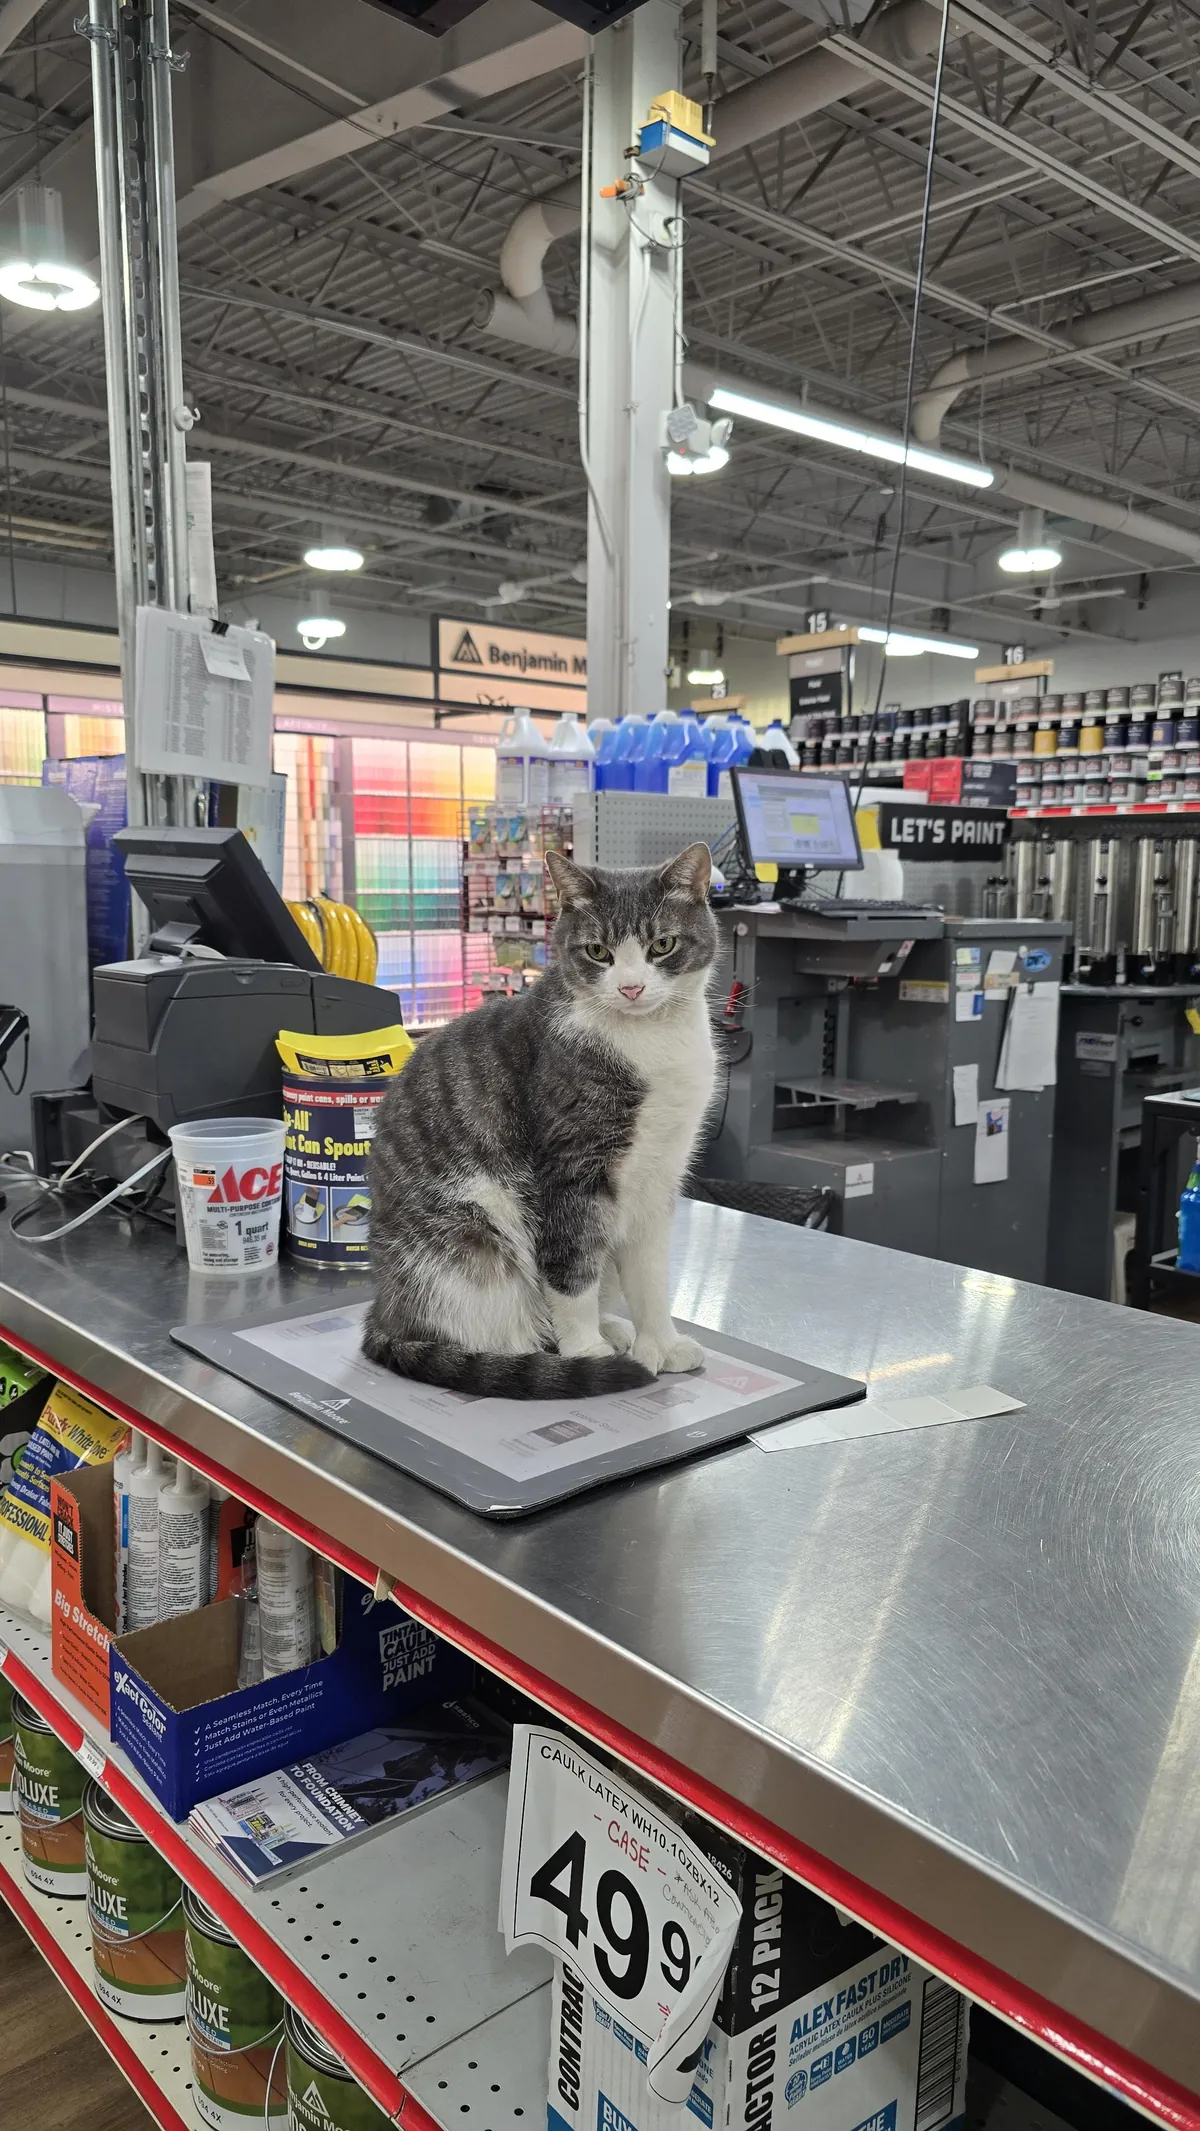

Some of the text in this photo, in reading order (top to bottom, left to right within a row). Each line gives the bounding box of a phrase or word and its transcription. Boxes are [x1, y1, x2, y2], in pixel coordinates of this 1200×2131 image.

[808, 612, 827, 634] 15
[489, 643, 567, 673] Benjamin
[1005, 646, 1024, 665] 16
[891, 818, 1005, 844] LET'S PAINT
[336, 1094, 357, 1106] spills
[359, 1096, 368, 1104] or
[297, 1134, 371, 1160] Can Spout
[207, 1163, 282, 1203] ACE
[207, 1203, 260, 1213] MULTI-PURPOSE
[235, 1221, 242, 1236] 1
[246, 1222, 269, 1236] quart
[320, 1409, 347, 1424] Moore
[55, 1589, 71, 1618] Big
[72, 1611, 109, 1653] Stretch
[383, 1643, 436, 1674] JUST ADD
[382, 1654, 436, 1692] PAINT
[113, 1670, 167, 1736] eXact Color
[204, 1689, 323, 1741] Match Stains or Even Metallics
[205, 1723, 212, 1731] A
[213, 1708, 252, 1728] Seamless
[281, 1688, 303, 1702] Every
[304, 1679, 323, 1692] Time
[453, 1705, 480, 1728] sashco
[204, 1702, 315, 1752] Just Add Water-Based Paint
[23, 1759, 50, 1778] Moore
[540, 1745, 586, 1783] CAULK
[588, 1776, 629, 1818] LATEX
[278, 1790, 286, 1800] for
[283, 1797, 297, 1814] every
[290, 1765, 355, 1832] TO FOUNDATION
[302, 1762, 328, 1790] FROM
[325, 1785, 365, 1824] CHIMNEY
[281, 1778, 318, 1820] high-performance
[315, 1815, 333, 1837] sealant
[607, 1820, 651, 1872] CASE
[92, 1866, 118, 1886] Moore
[707, 1852, 733, 1880] 18426
[44, 1874, 55, 1886] 4X
[750, 1868, 783, 2013] 12 PACK
[192, 1967, 220, 1994] Moore
[111, 1995, 122, 2005] 4X
[788, 1953, 910, 2046] ALEX FAST DRY
[788, 1972, 912, 2058] ACRYLIC LATEX CAULK PLUS SILICONE
[836, 2029, 844, 2039] de
[861, 2039, 875, 2053] YEAR
[862, 2026, 875, 2042] 50
